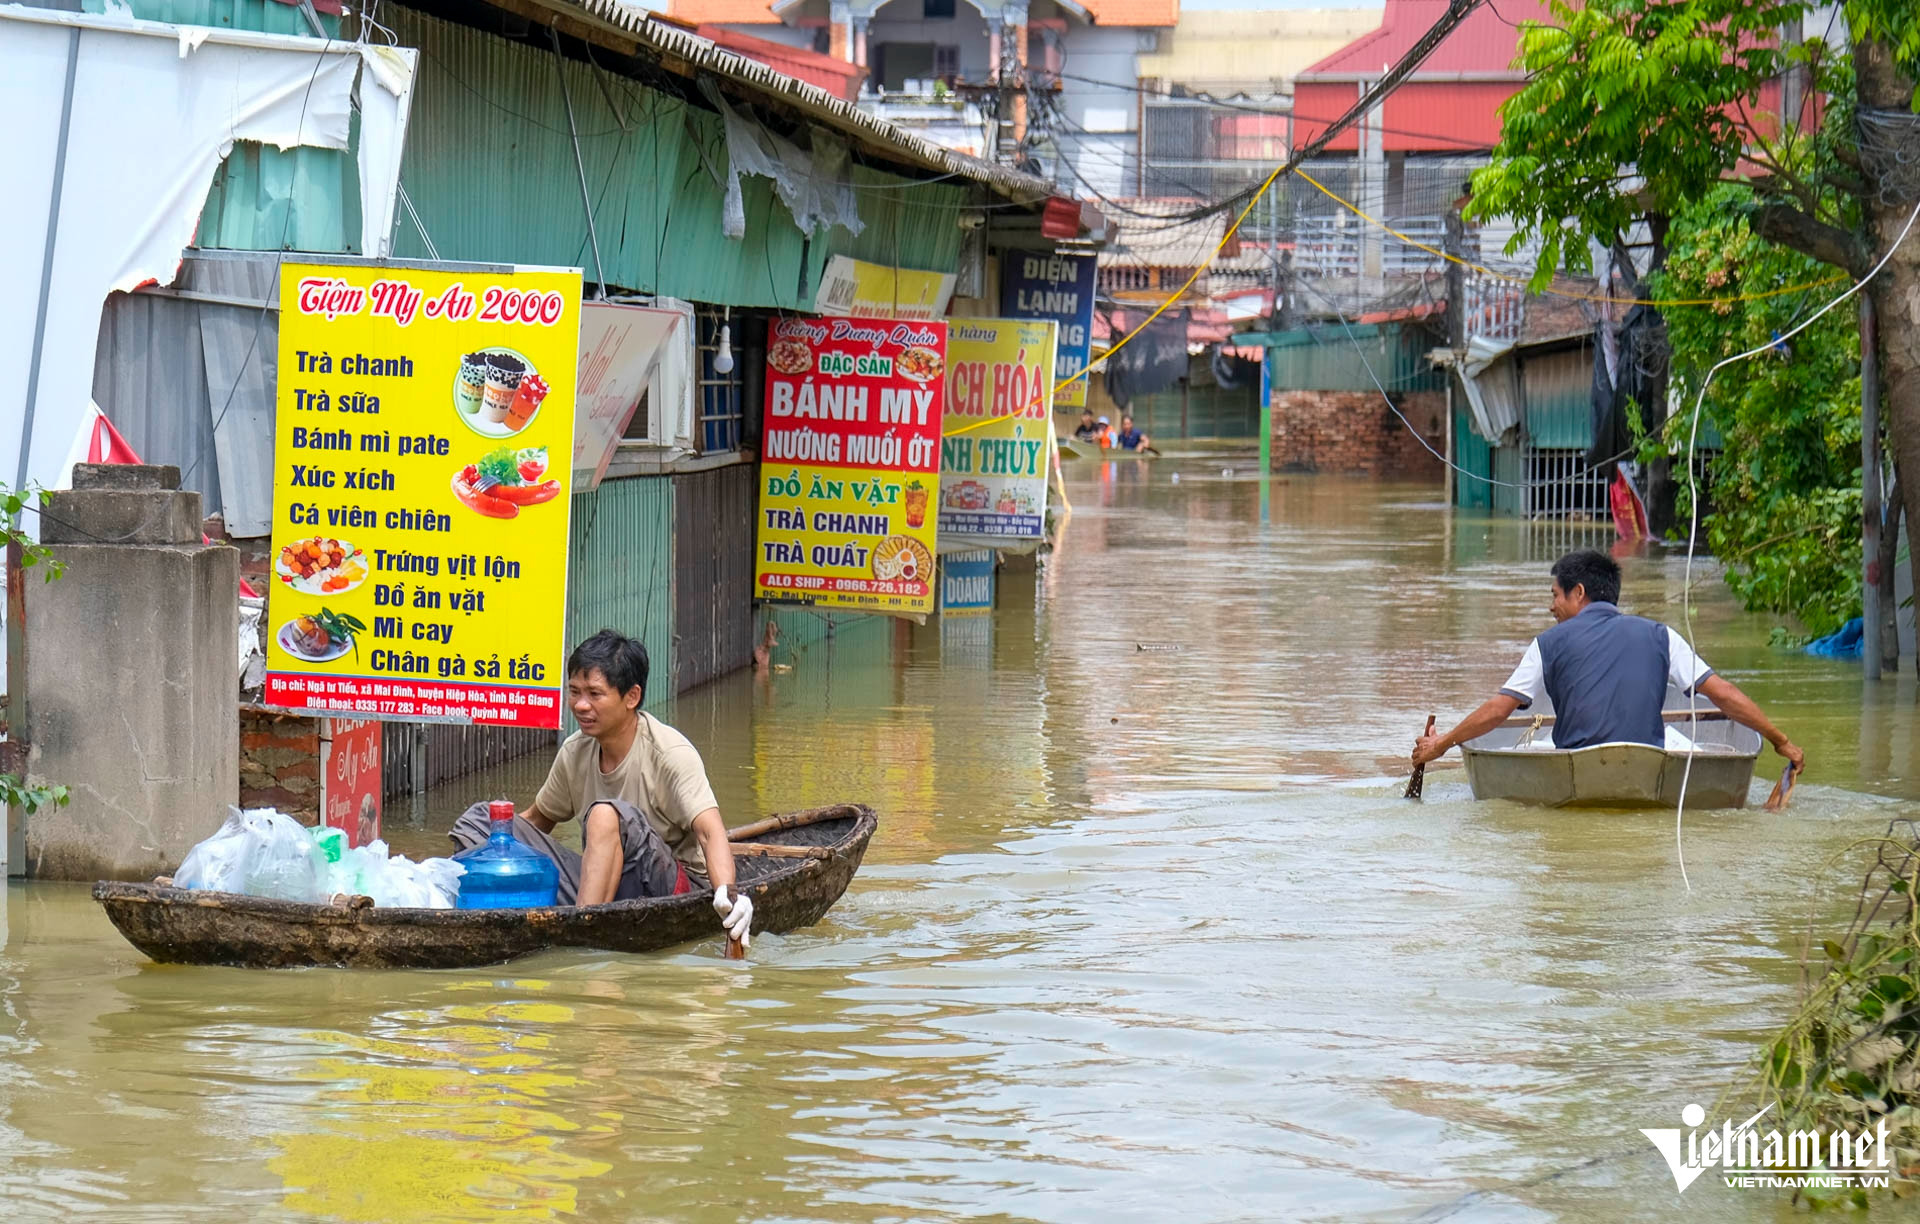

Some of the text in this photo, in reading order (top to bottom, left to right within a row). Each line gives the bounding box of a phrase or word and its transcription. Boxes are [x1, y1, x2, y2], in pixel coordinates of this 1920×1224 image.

[1024, 255, 1078, 286] ĐIỆN
[300, 280, 563, 325] Tiệm My An 2000
[1018, 288, 1078, 316] LẠNH
[959, 325, 996, 342] hàng
[296, 350, 414, 378] Trà chanh
[821, 352, 891, 377] ĐẶC SẢN
[991, 349, 1045, 419] HÓA
[295, 389, 380, 415] Trà sữa
[771, 377, 934, 425] BÁNH MỲ
[292, 427, 450, 456] Bánh mì pate
[767, 426, 934, 468] NƯỚNG MUỐI ỚT
[979, 425, 1041, 475] THỦY
[291, 465, 395, 491] Xúc xích
[767, 469, 900, 507] ĐỒ ĂN VẶT
[290, 503, 451, 532] Cá viên chiên
[766, 507, 888, 536] TRÀ CHANH
[374, 549, 520, 583] Trứng vịt lộn
[764, 540, 868, 568] TRÀ QUẤT
[768, 575, 792, 587] ALO
[795, 576, 824, 589] SHIP
[946, 576, 990, 604] DOANH
[374, 582, 485, 616] Đồ ăn vặt
[838, 594, 856, 603] Mai
[858, 595, 880, 604] Đình
[374, 616, 454, 644] Mì cay
[371, 649, 545, 680] Chân gà sả tắc
[272, 678, 286, 692] Địa
[288, 679, 306, 692] chỉ:
[307, 680, 325, 693] Ngã
[327, 682, 336, 693] tư
[360, 684, 372, 694] xã
[374, 684, 390, 696] Mai
[392, 686, 416, 698] Đình,
[418, 687, 444, 702] huyện
[446, 688, 466, 703] Hiệp
[468, 690, 488, 704] Hòa,
[490, 690, 507, 704] tỉnh
[509, 690, 526, 705] Bắc
[528, 694, 554, 708] Giang
[355, 700, 377, 712] 0335
[379, 702, 396, 712] 177
[398, 702, 414, 714] 283
[422, 703, 442, 715] Face
[471, 706, 498, 720] Quỳnh
[500, 708, 517, 720] Mai
